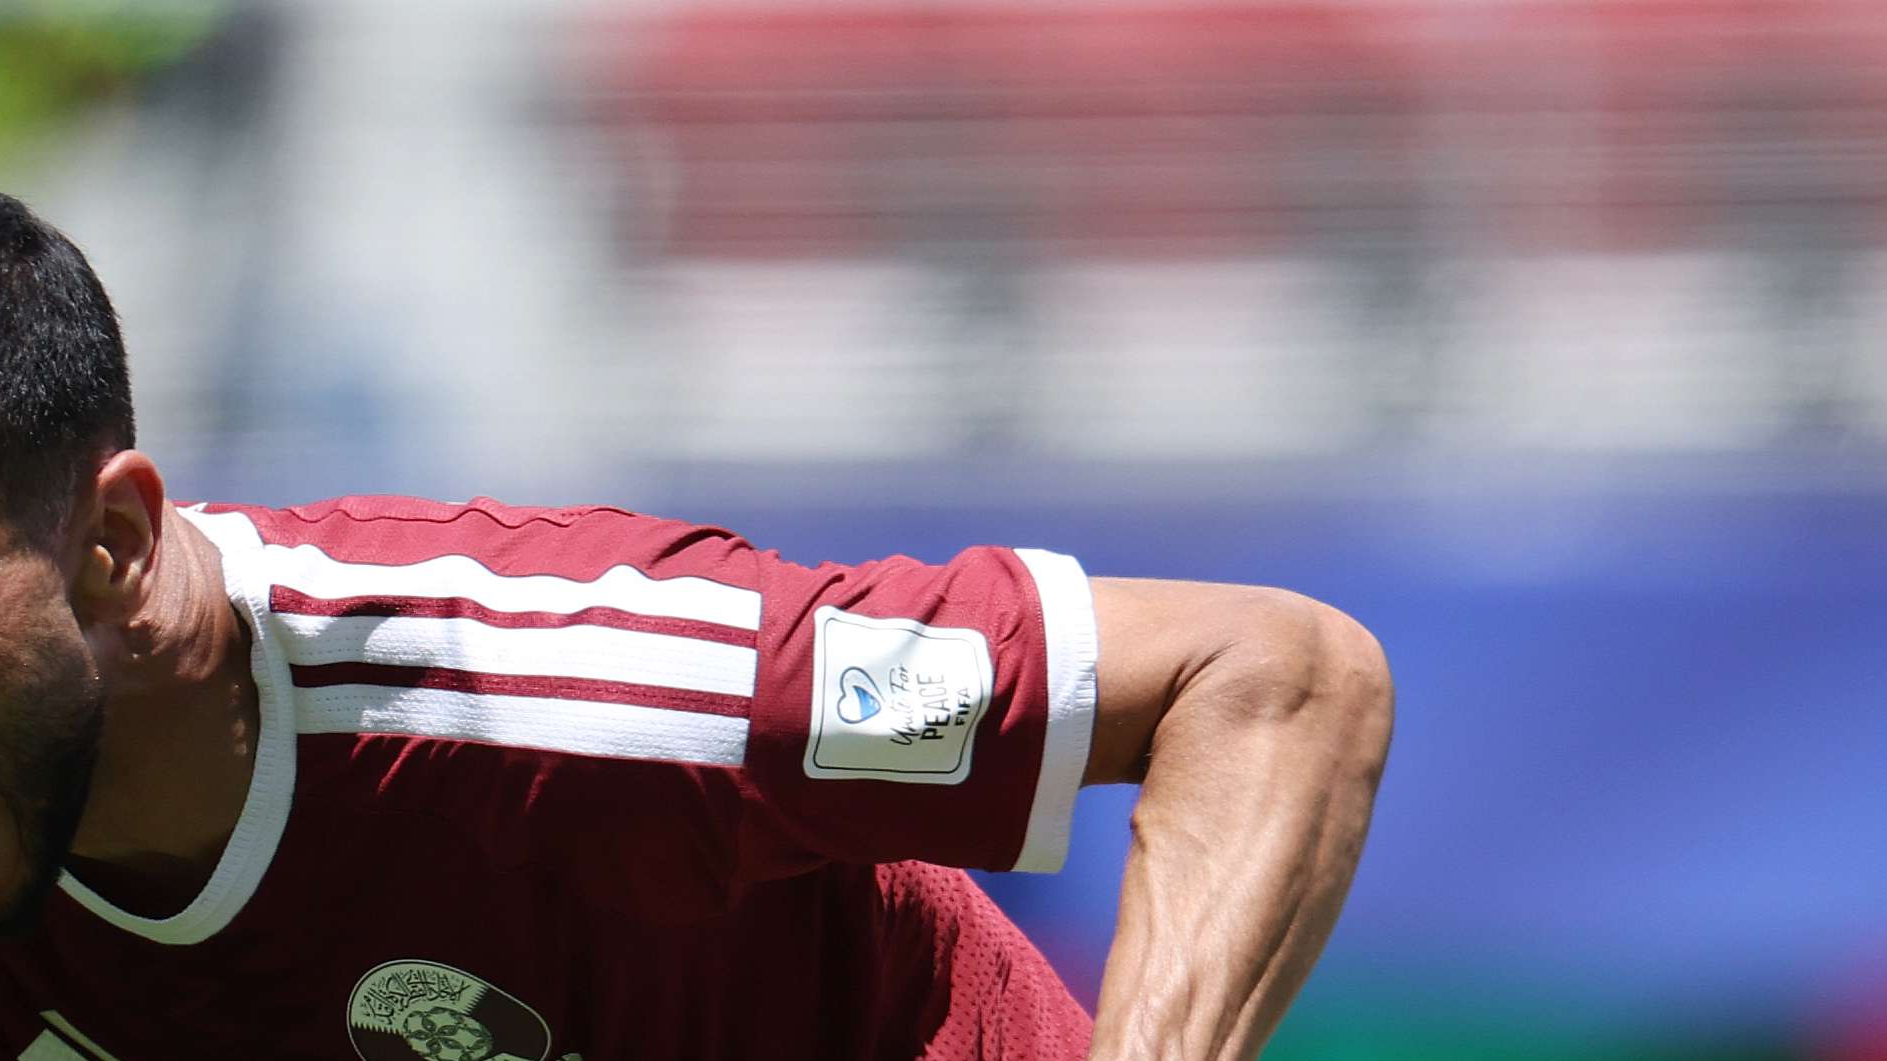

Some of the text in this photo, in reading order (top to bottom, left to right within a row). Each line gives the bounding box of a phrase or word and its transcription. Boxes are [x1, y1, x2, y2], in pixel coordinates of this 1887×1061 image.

[889, 664, 919, 745] Unite For
[916, 673, 951, 740] PEACE
[954, 688, 970, 726] FIFA
